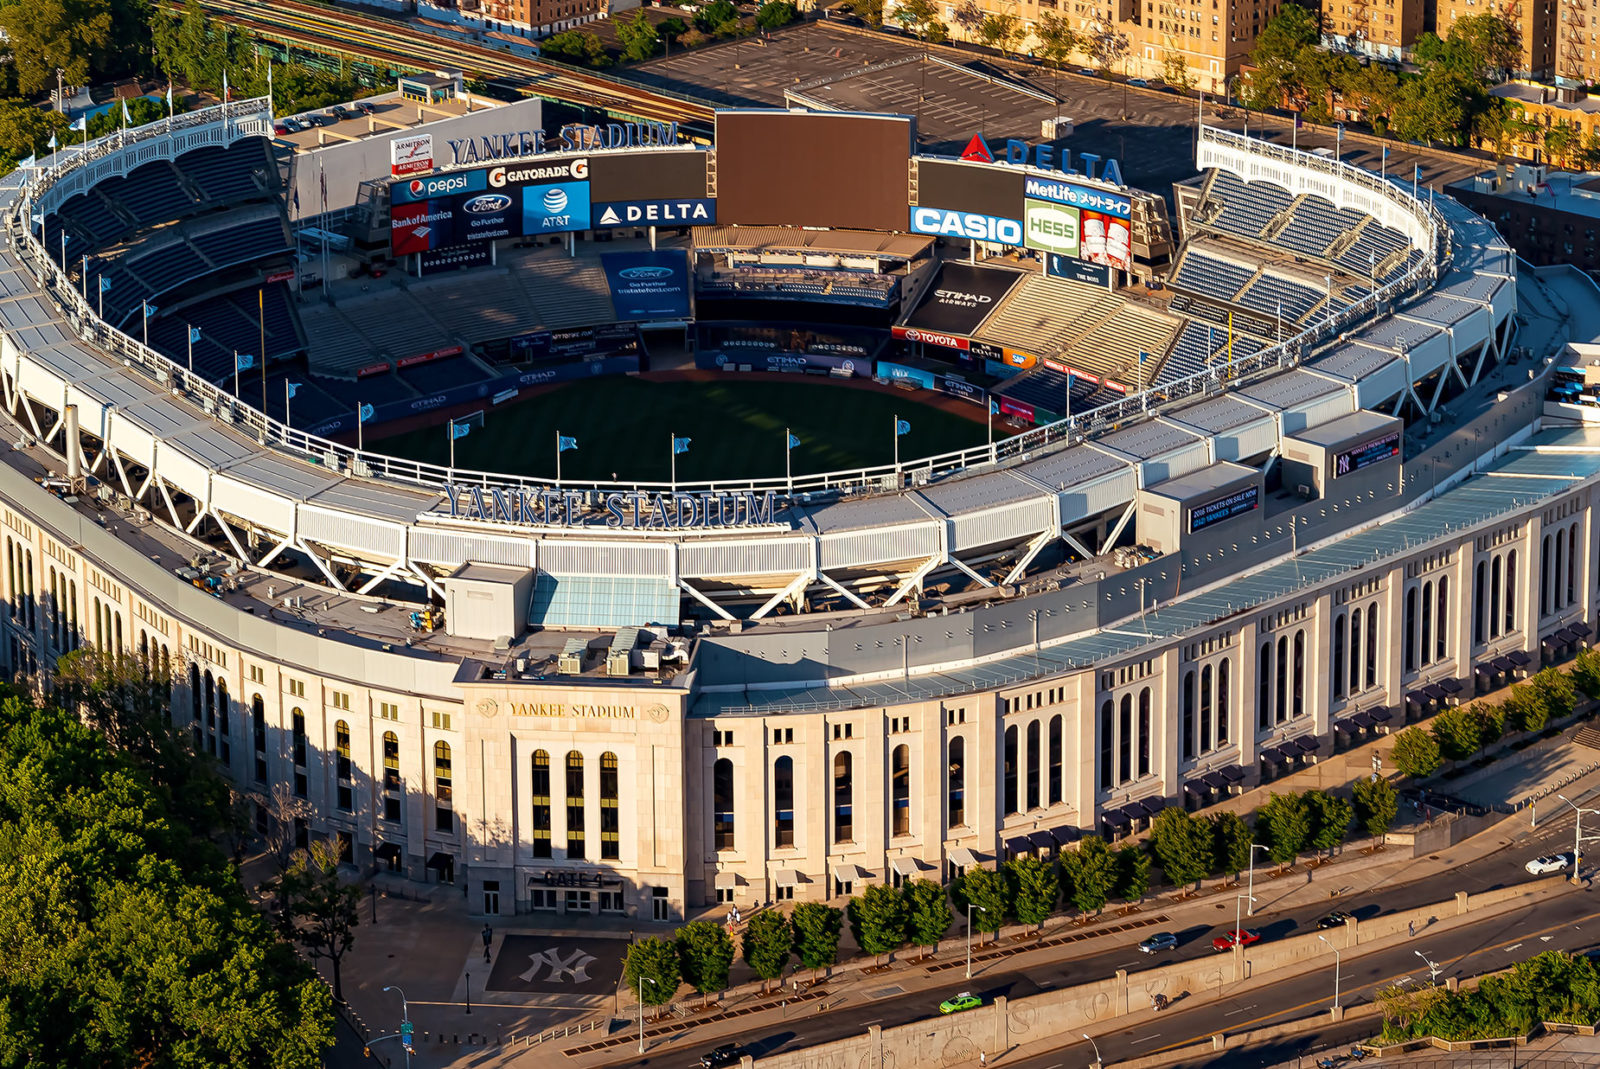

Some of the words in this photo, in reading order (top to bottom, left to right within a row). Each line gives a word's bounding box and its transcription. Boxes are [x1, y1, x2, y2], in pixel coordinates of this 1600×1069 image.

[395, 139, 431, 150] ARMITRON
[448, 129, 547, 165] YANKEE
[559, 121, 679, 151] STADIUM
[398, 160, 429, 170] ARMITRON
[1007, 139, 1124, 186] DELTA
[488, 167, 506, 188] G
[507, 165, 570, 182] GATORADE
[570, 159, 589, 179] G
[428, 174, 468, 195] pepsi
[1026, 181, 1078, 202] MetLife
[472, 198, 502, 212] Ford
[1080, 193, 1131, 215] メットライフ
[392, 218, 411, 228] Bank
[412, 214, 420, 224] of
[420, 210, 453, 223] America
[627, 203, 709, 221] DELTA
[481, 217, 505, 226] Further
[542, 215, 571, 227] AT&T
[915, 208, 1022, 245] CASIO
[1031, 217, 1074, 239] HESS
[629, 269, 662, 278] Ford
[934, 289, 991, 304] ETIHAD
[939, 299, 977, 308] AIRWAYS
[921, 332, 958, 347] TOYOTA
[767, 356, 807, 365] ETIHAD
[971, 347, 1000, 359] COACH
[1012, 354, 1025, 364] SAP
[520, 370, 556, 383] ETIHAD
[945, 380, 974, 394] ETIHAD
[411, 395, 446, 409] ETIHAD
[1339, 454, 1350, 474] NY
[443, 481, 586, 527] YANKEE
[605, 490, 777, 529] STADIUM
[1206, 501, 1225, 513] TICKETS
[1206, 507, 1230, 522] YANKEES
[510, 702, 566, 717] YANKEE
[572, 703, 635, 719] STADIUM
[519, 947, 598, 984] NY
